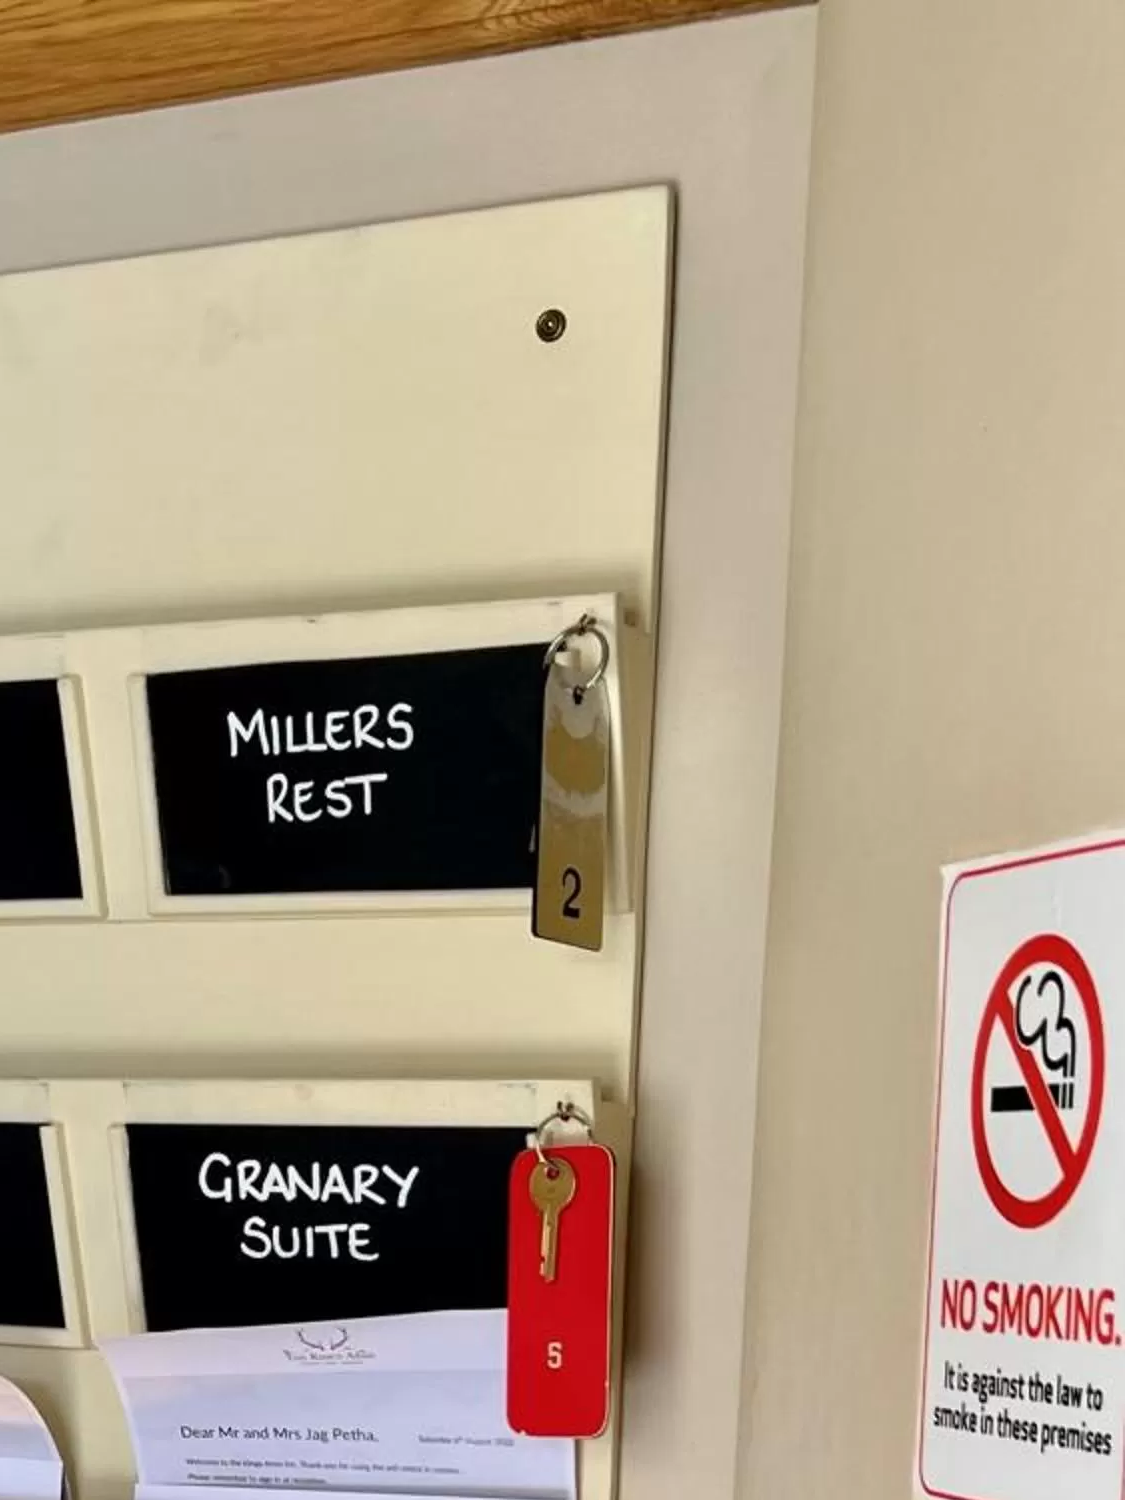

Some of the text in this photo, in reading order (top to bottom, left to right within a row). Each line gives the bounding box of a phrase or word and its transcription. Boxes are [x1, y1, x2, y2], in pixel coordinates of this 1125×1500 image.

[227, 703, 415, 757] MILLERS
[266, 773, 387, 823] REST
[561, 867, 582, 919] 2
[198, 1152, 420, 1208] GRANARY
[240, 1216, 380, 1261] SUITE
[940, 1278, 1122, 1346] NO SMOKING.
[944, 1359, 1104, 1411] It is against the law to
[180, 1426, 215, 1439] Dear
[218, 1427, 238, 1439] Mr
[243, 1427, 269, 1440] and
[274, 1428, 302, 1441] Mrs
[306, 1428, 329, 1443] Jag
[934, 1402, 1113, 1456] smoke in these premises
